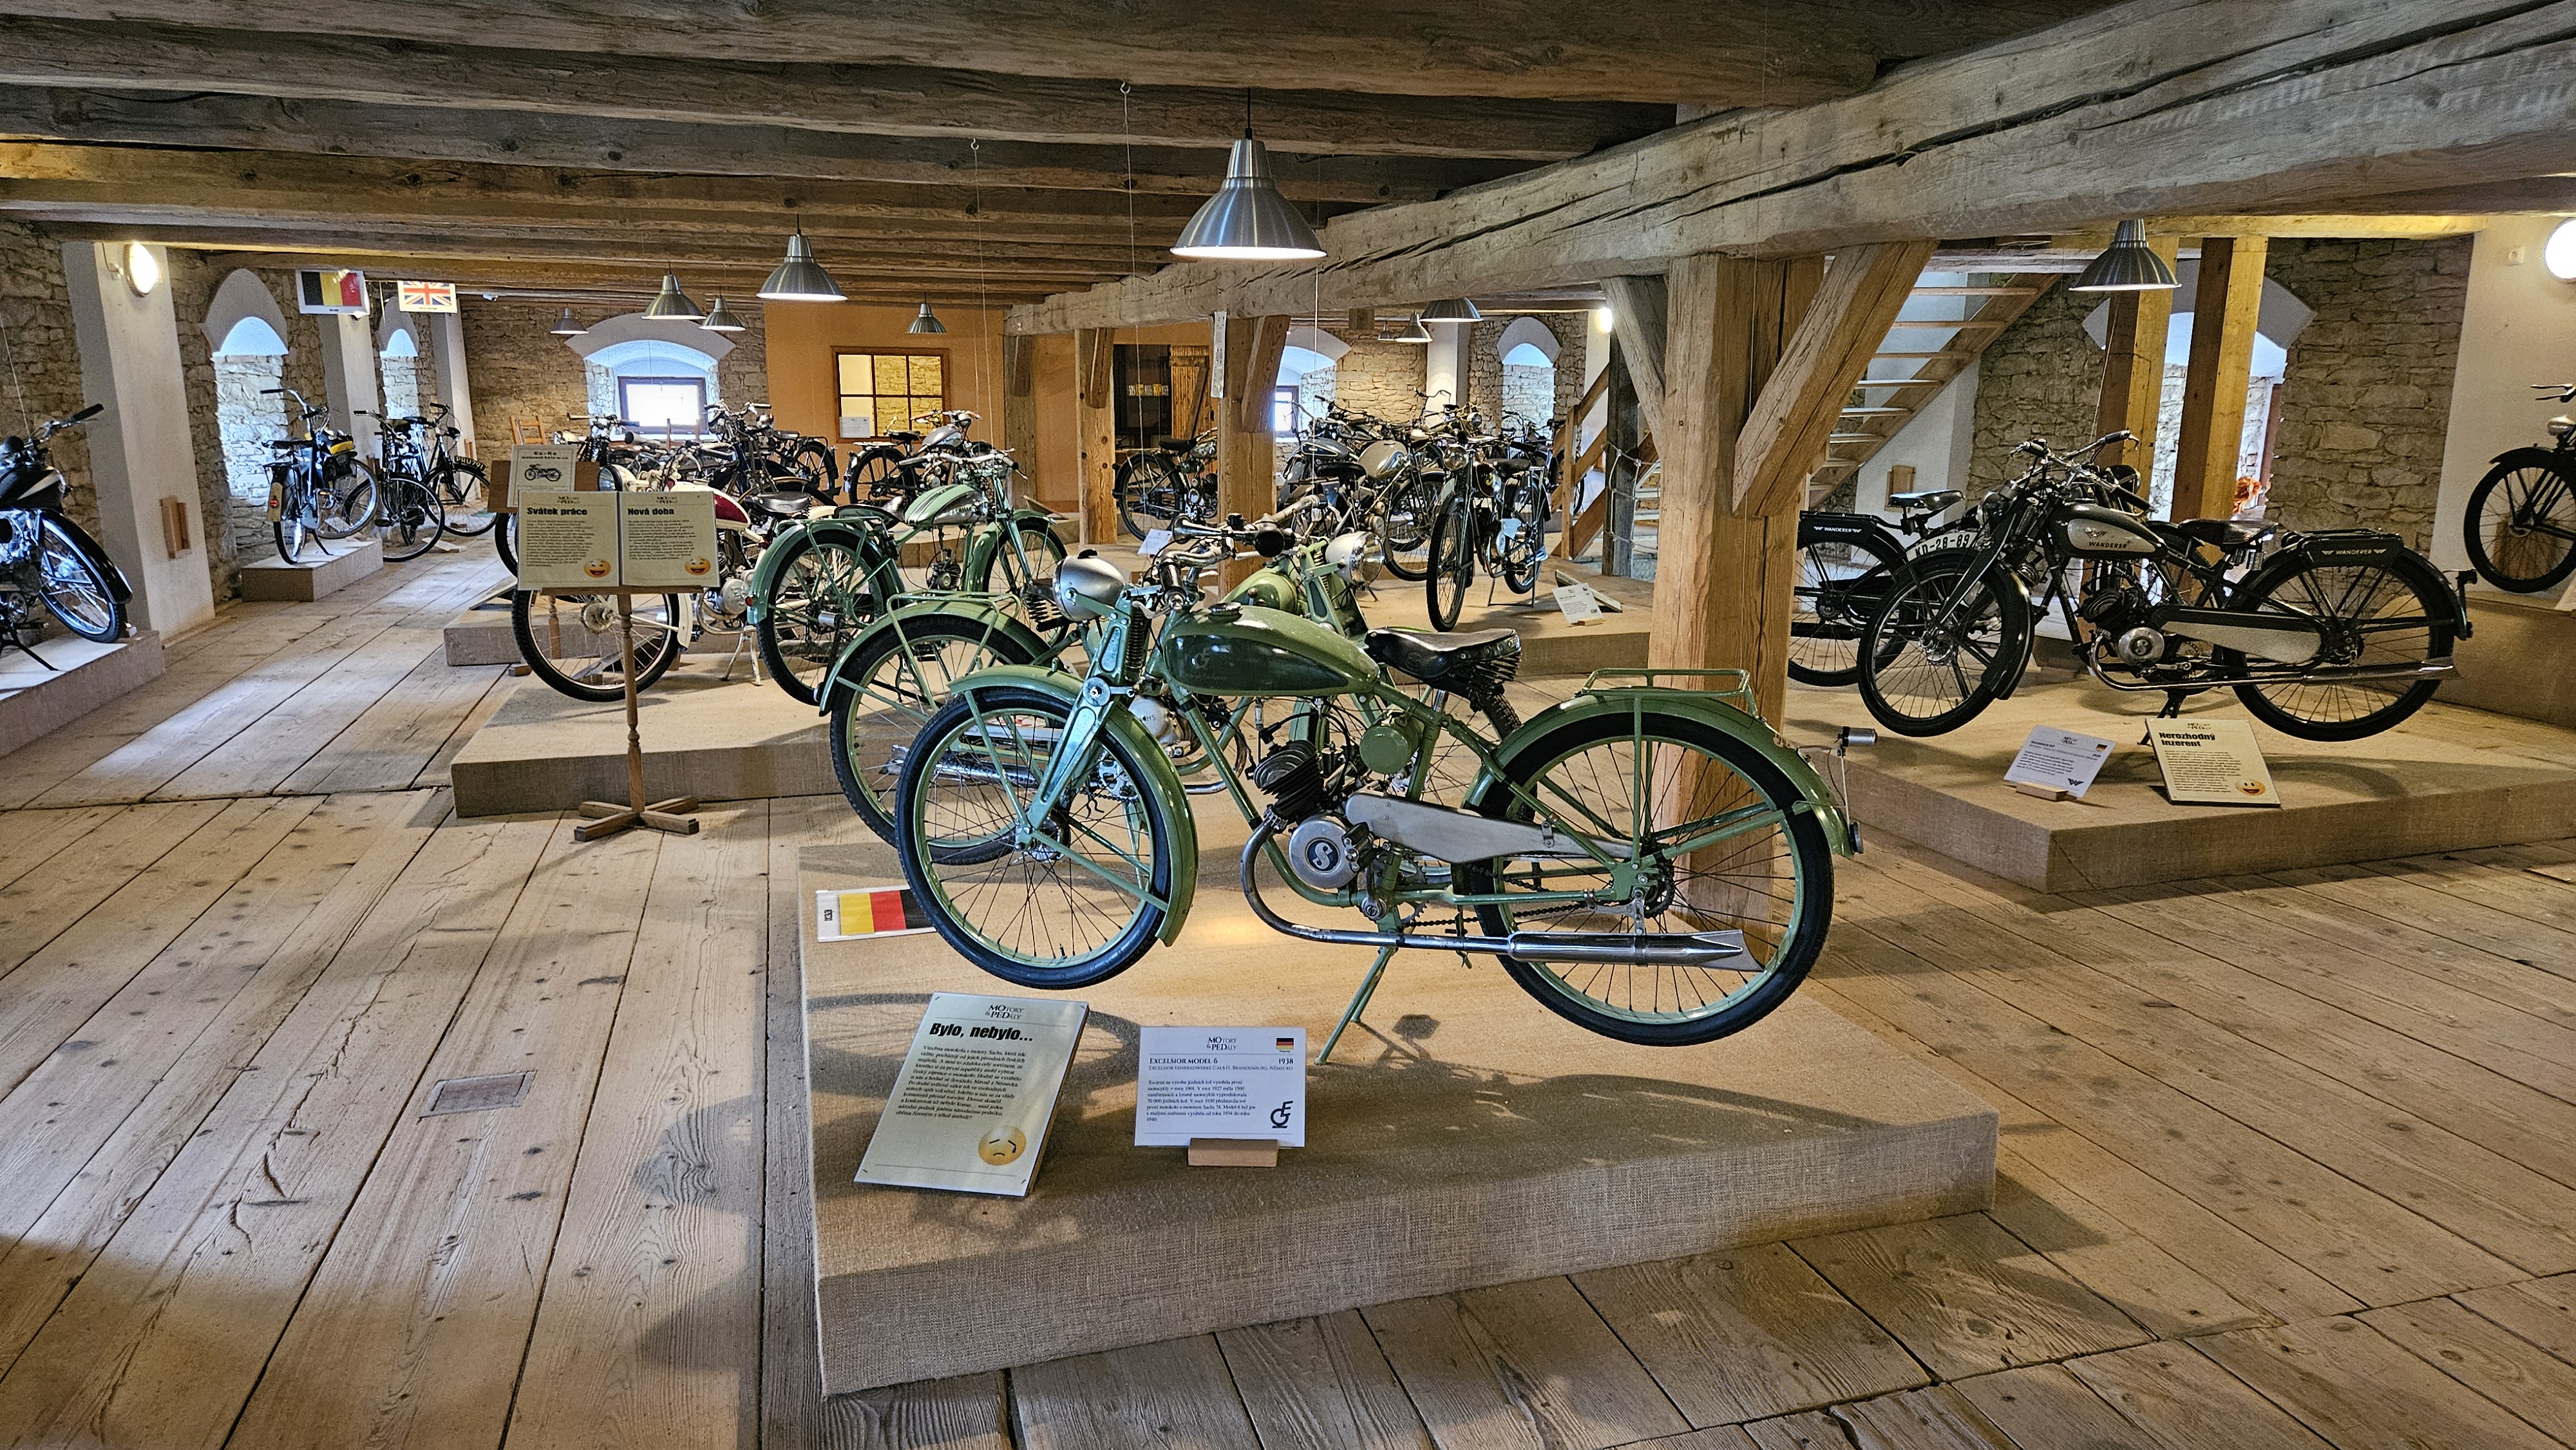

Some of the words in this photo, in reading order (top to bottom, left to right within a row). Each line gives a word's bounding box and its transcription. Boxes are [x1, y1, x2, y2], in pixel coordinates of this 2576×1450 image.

[561, 507, 587, 516] práce
[2159, 732, 2215, 740] Nerozhodný
[929, 1023, 964, 1038] Bylo,
